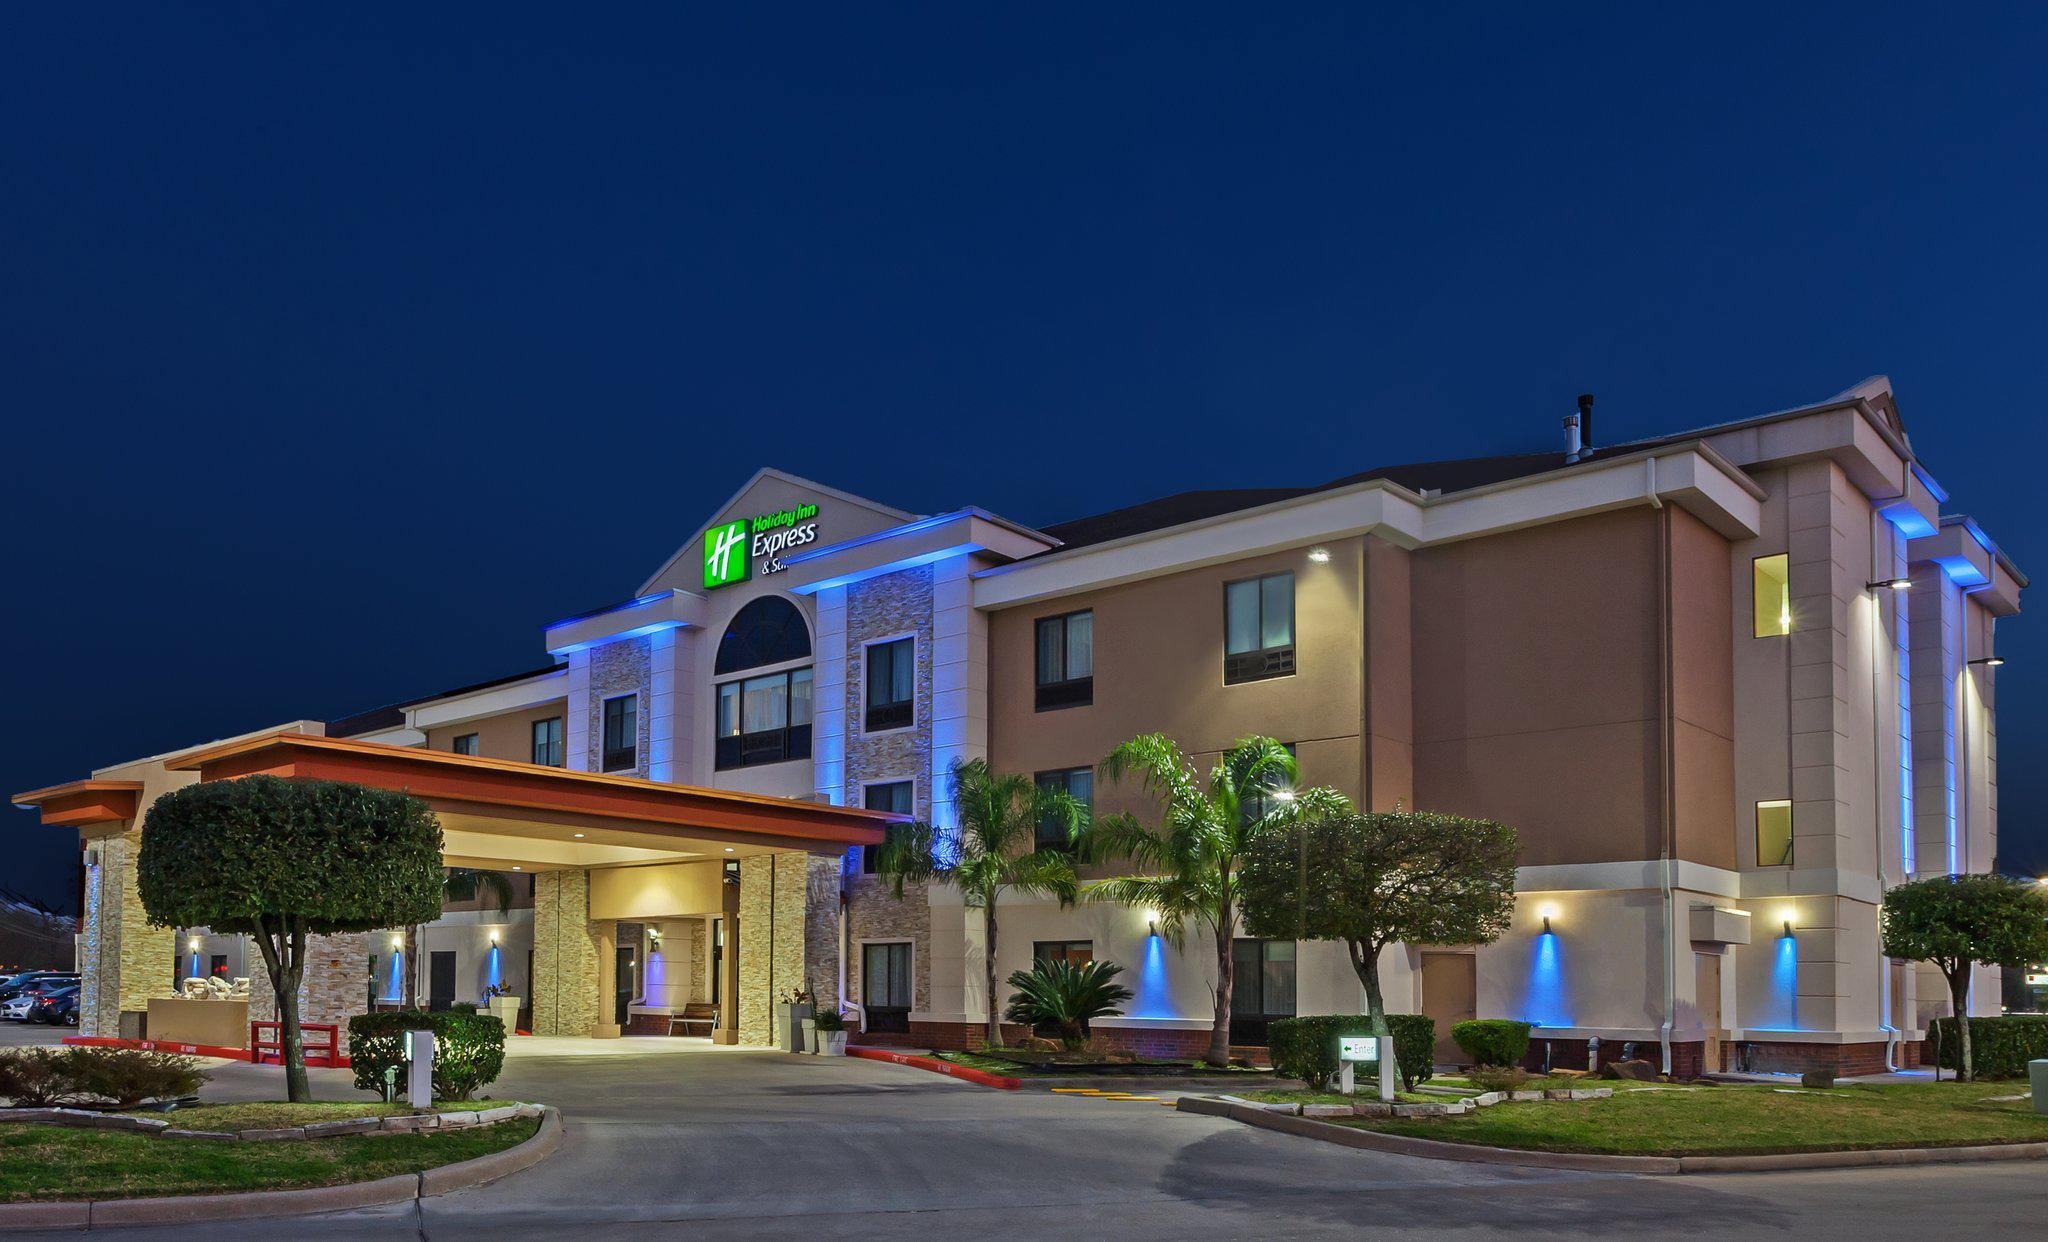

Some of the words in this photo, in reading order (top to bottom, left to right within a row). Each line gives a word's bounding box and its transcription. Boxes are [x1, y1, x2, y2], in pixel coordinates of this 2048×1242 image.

[752, 510, 796, 533] Holiday
[796, 503, 817, 521] Inn
[752, 523, 816, 558] Express
[761, 560, 770, 574] &
[1354, 1043, 1375, 1054] Enter
